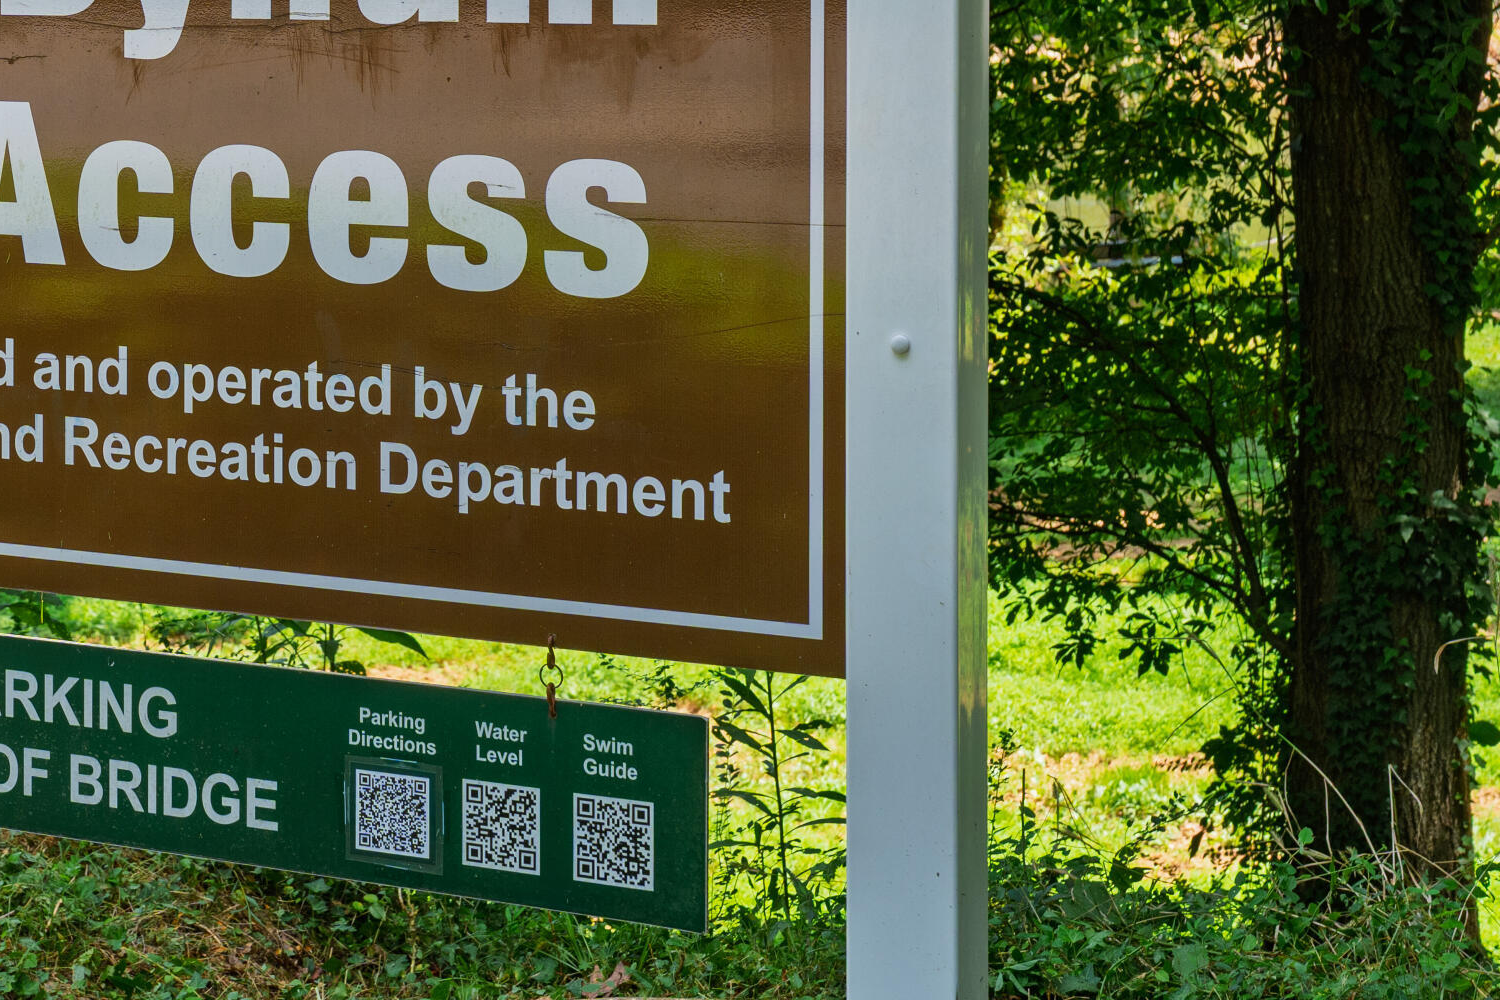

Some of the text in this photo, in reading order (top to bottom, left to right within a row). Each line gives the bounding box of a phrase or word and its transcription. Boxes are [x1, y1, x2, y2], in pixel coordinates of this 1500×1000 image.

[34, 346, 127, 395] and
[148, 361, 390, 415] operated
[415, 366, 482, 435] by
[502, 374, 595, 430] the
[65, 417, 355, 489] Recreation
[381, 442, 730, 523] Department
[360, 707, 425, 734] Parking
[475, 721, 527, 742] Water
[349, 729, 436, 755] Directions
[584, 734, 632, 755] Swim
[476, 745, 522, 766] Level
[584, 758, 637, 780] Guide
[71, 754, 278, 831] BRIDGE
